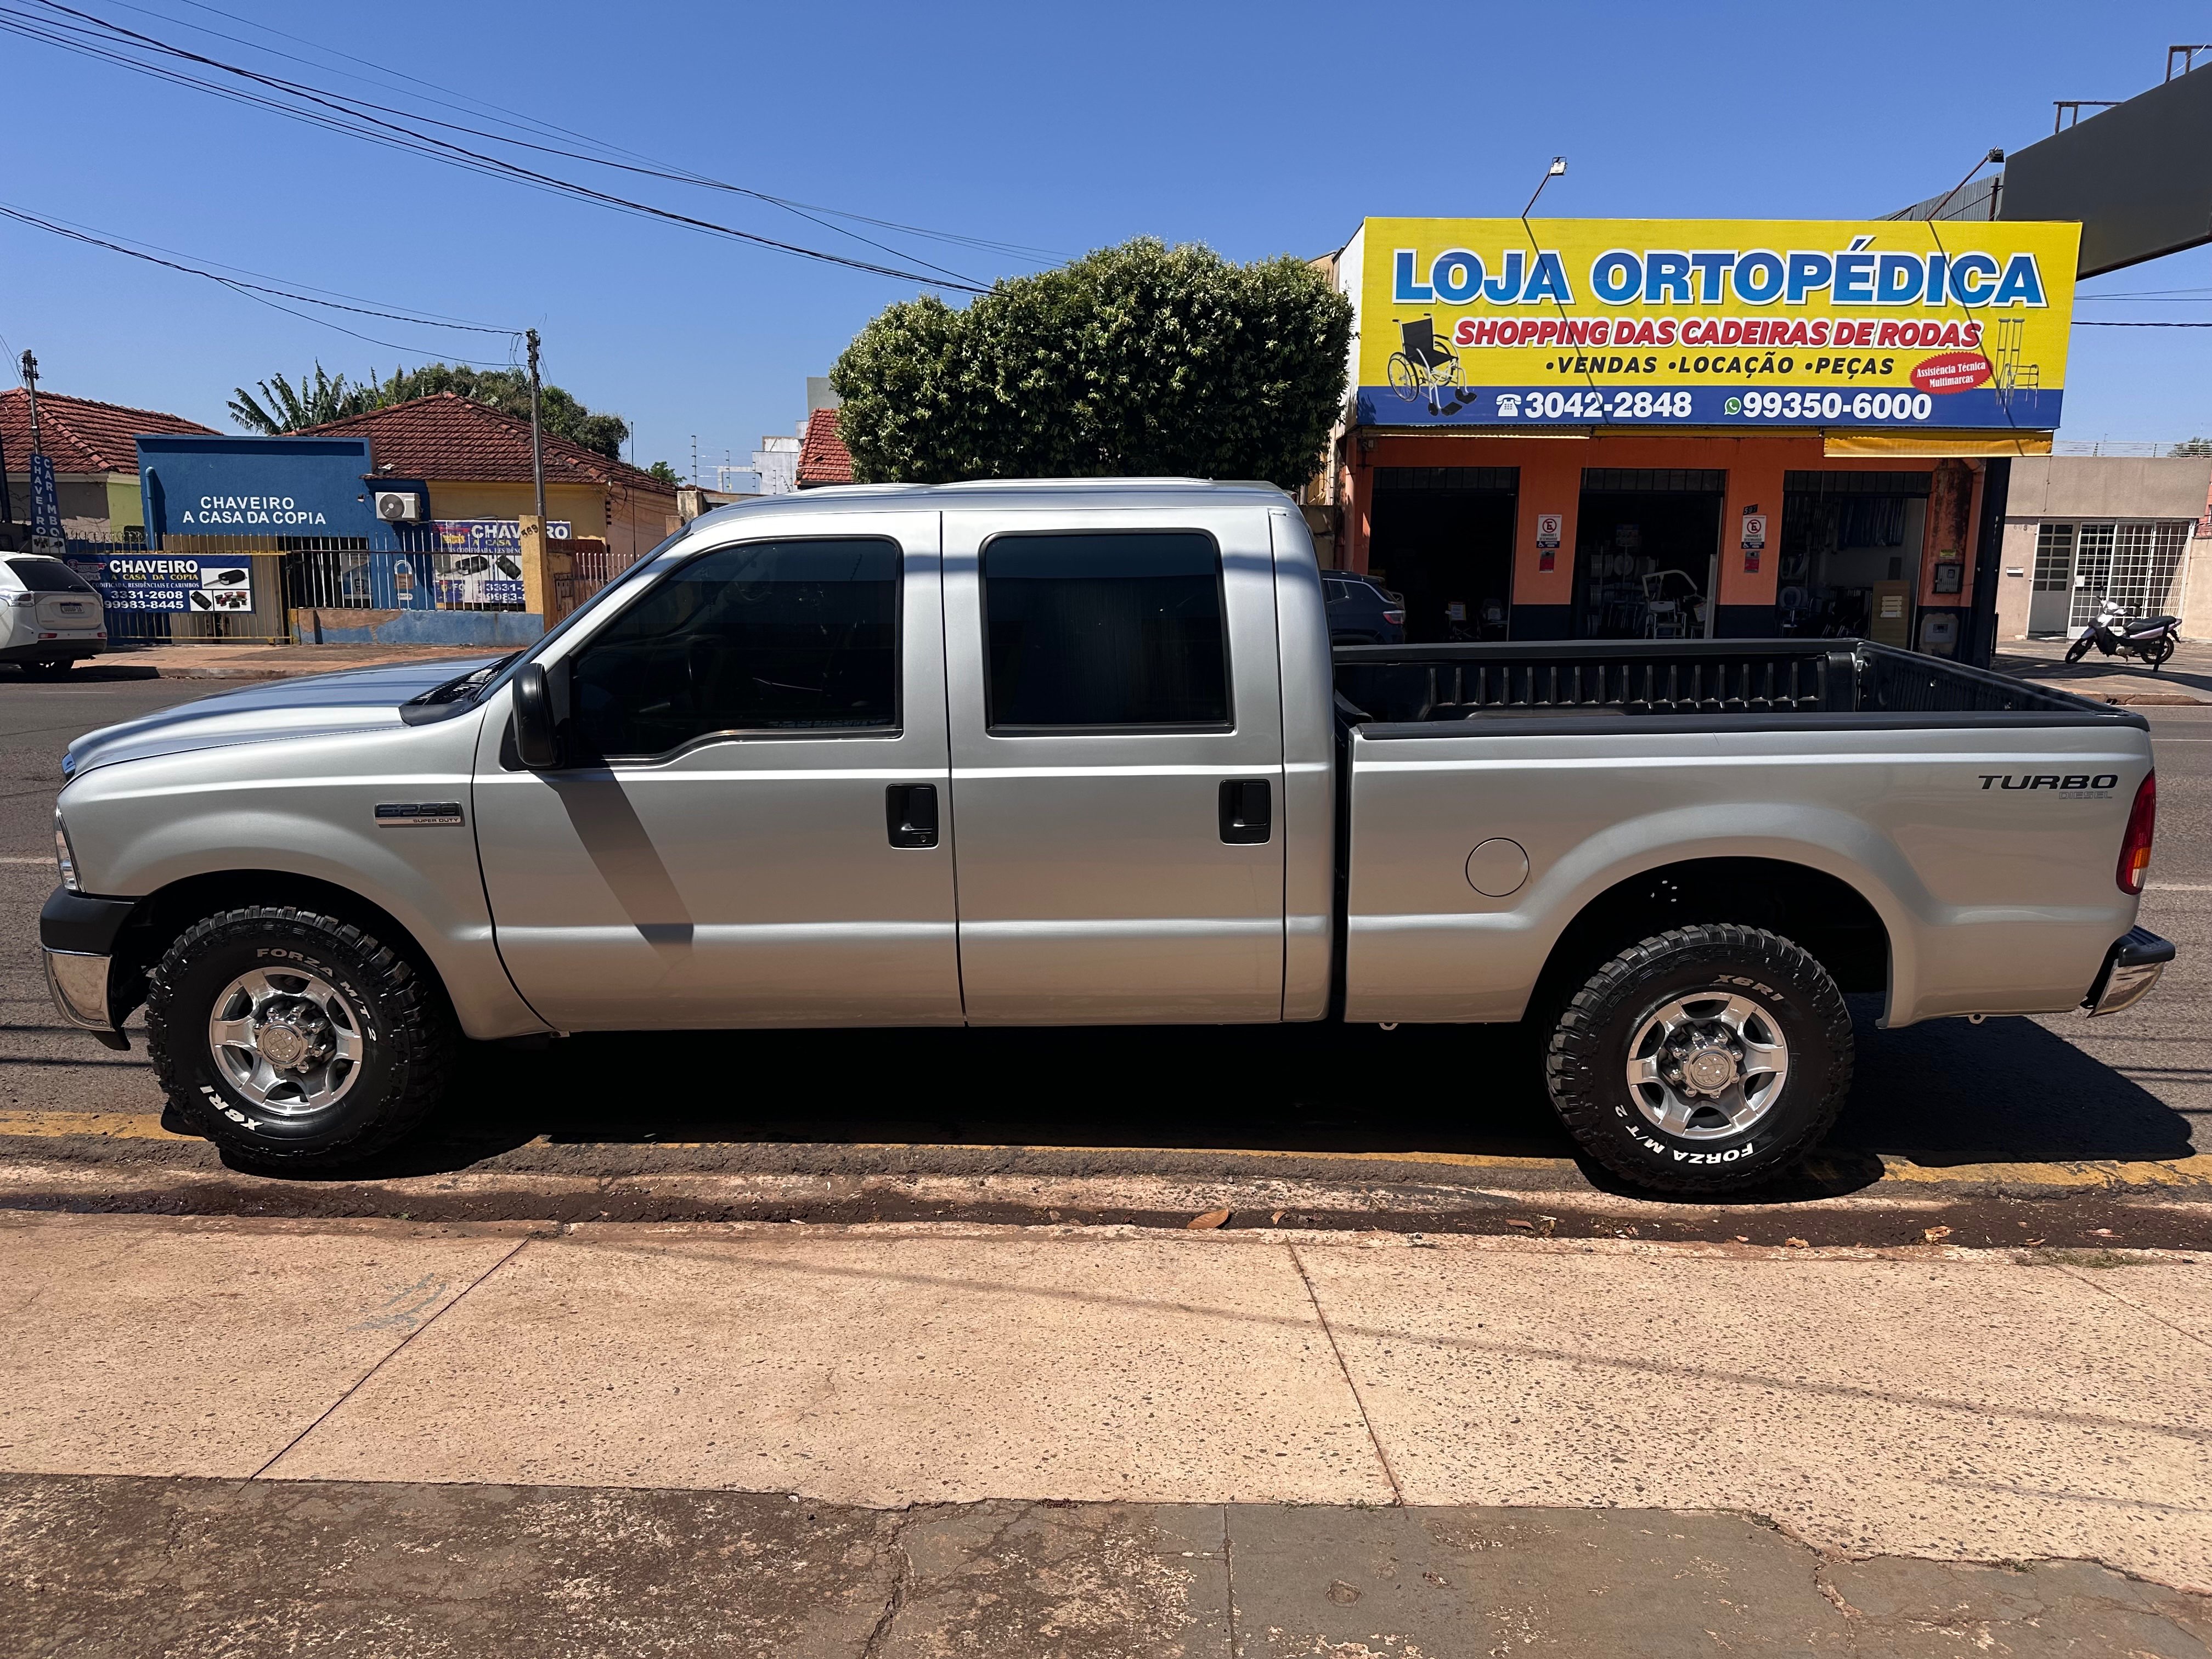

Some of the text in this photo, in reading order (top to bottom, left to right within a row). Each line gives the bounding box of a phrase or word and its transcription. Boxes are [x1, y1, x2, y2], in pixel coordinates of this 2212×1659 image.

[1392, 235, 2049, 307] LOJA ORTOPÉDICA
[1454, 319, 1983, 348] SHOPPING DAS CADEIRAS DE RODAS
[1916, 361, 1986, 378] Assistência Técnica
[1929, 375, 1974, 388] Multimarcas
[1525, 391, 1692, 419] 3042-2848
[1742, 392, 1932, 420] 99350-6000
[33, 455, 46, 535] CHAVEIRO
[43, 459, 60, 537] CARIMBO
[200, 496, 295, 510] CHAVEIRO
[183, 511, 326, 524] A CASA DA COPIA
[110, 560, 199, 574] CHAVEIRO
[170, 572, 199, 580] CÓPIA
[104, 601, 184, 609] 99983-8445
[111, 590, 184, 599] 3331-2608
[1978, 774, 2118, 789] TURBO
[2058, 791, 2113, 800] DIESEL
[257, 948, 377, 1041] FORZA M/T 2
[1712, 974, 1785, 1001] XBRI
[200, 1085, 264, 1131] XBRI
[1615, 1104, 1754, 1164] FORZA M/T 2
